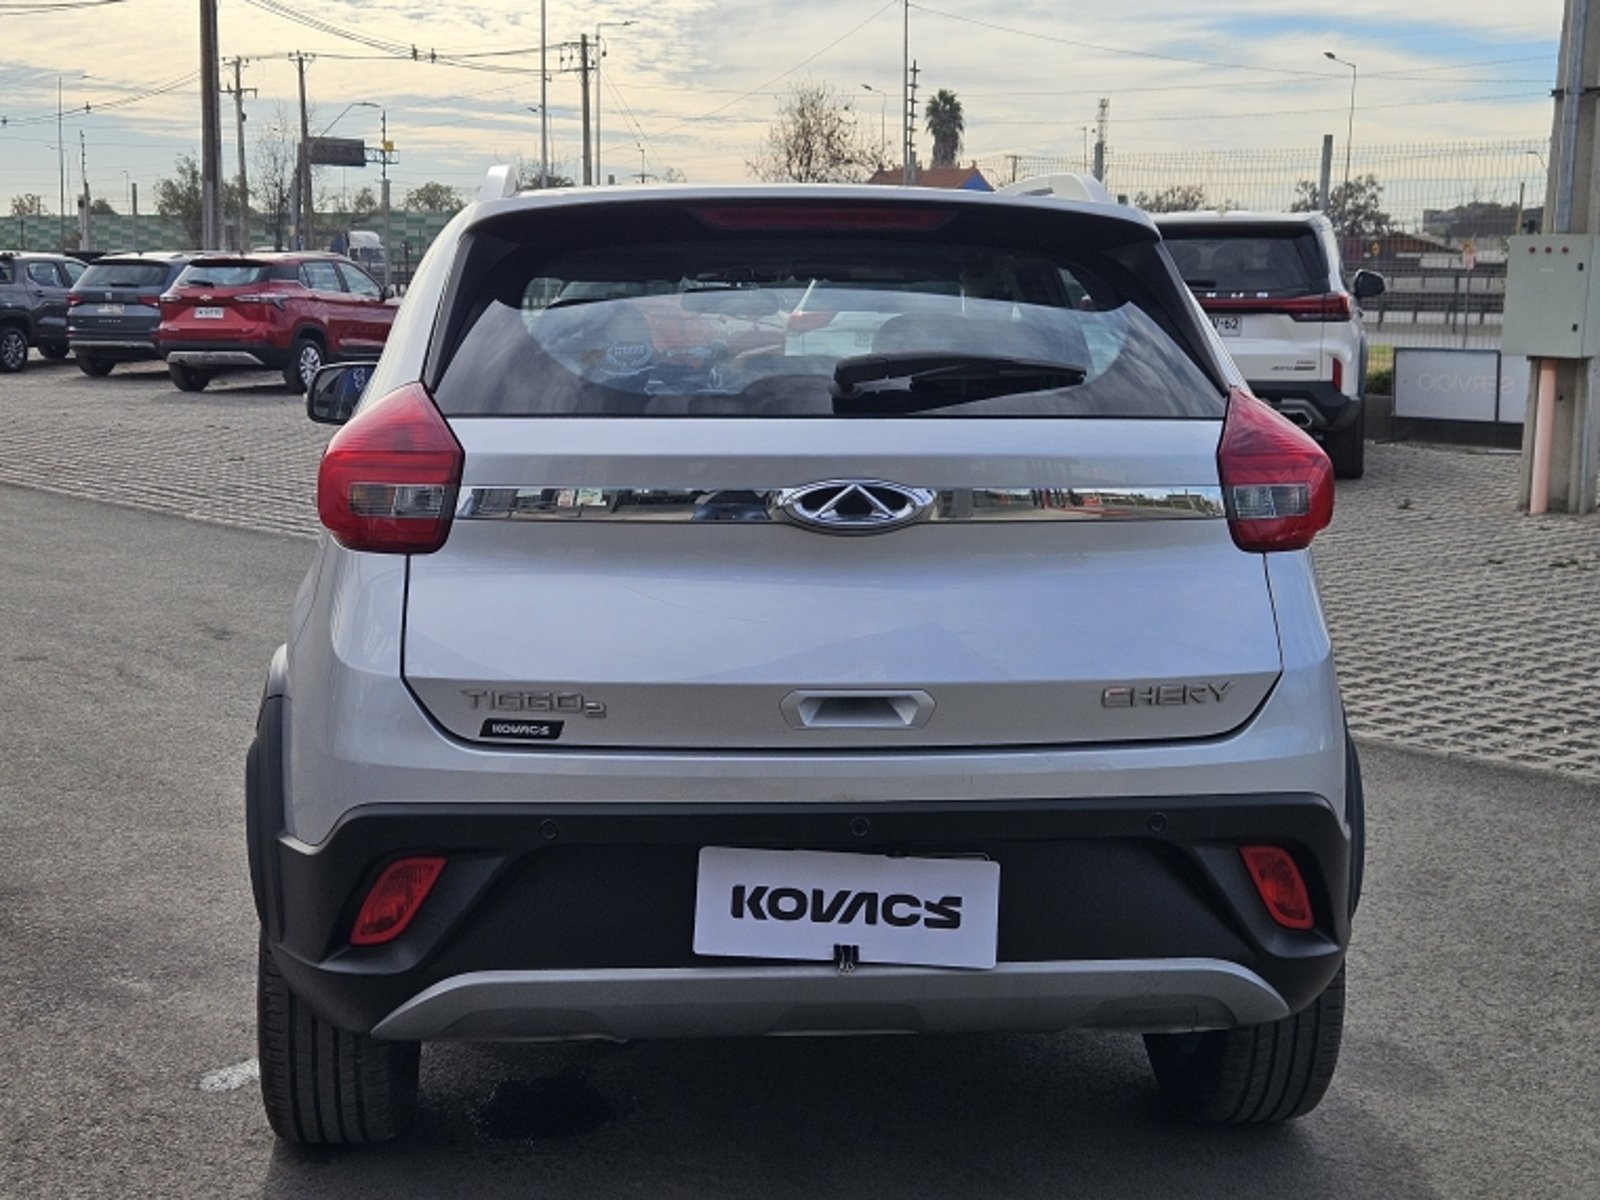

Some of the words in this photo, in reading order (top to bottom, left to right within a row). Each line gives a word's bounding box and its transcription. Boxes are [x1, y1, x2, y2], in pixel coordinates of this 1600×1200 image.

[1101, 681, 1235, 708] CHERY
[491, 723, 550, 735] KOVACS
[730, 884, 963, 929] KOVACS
